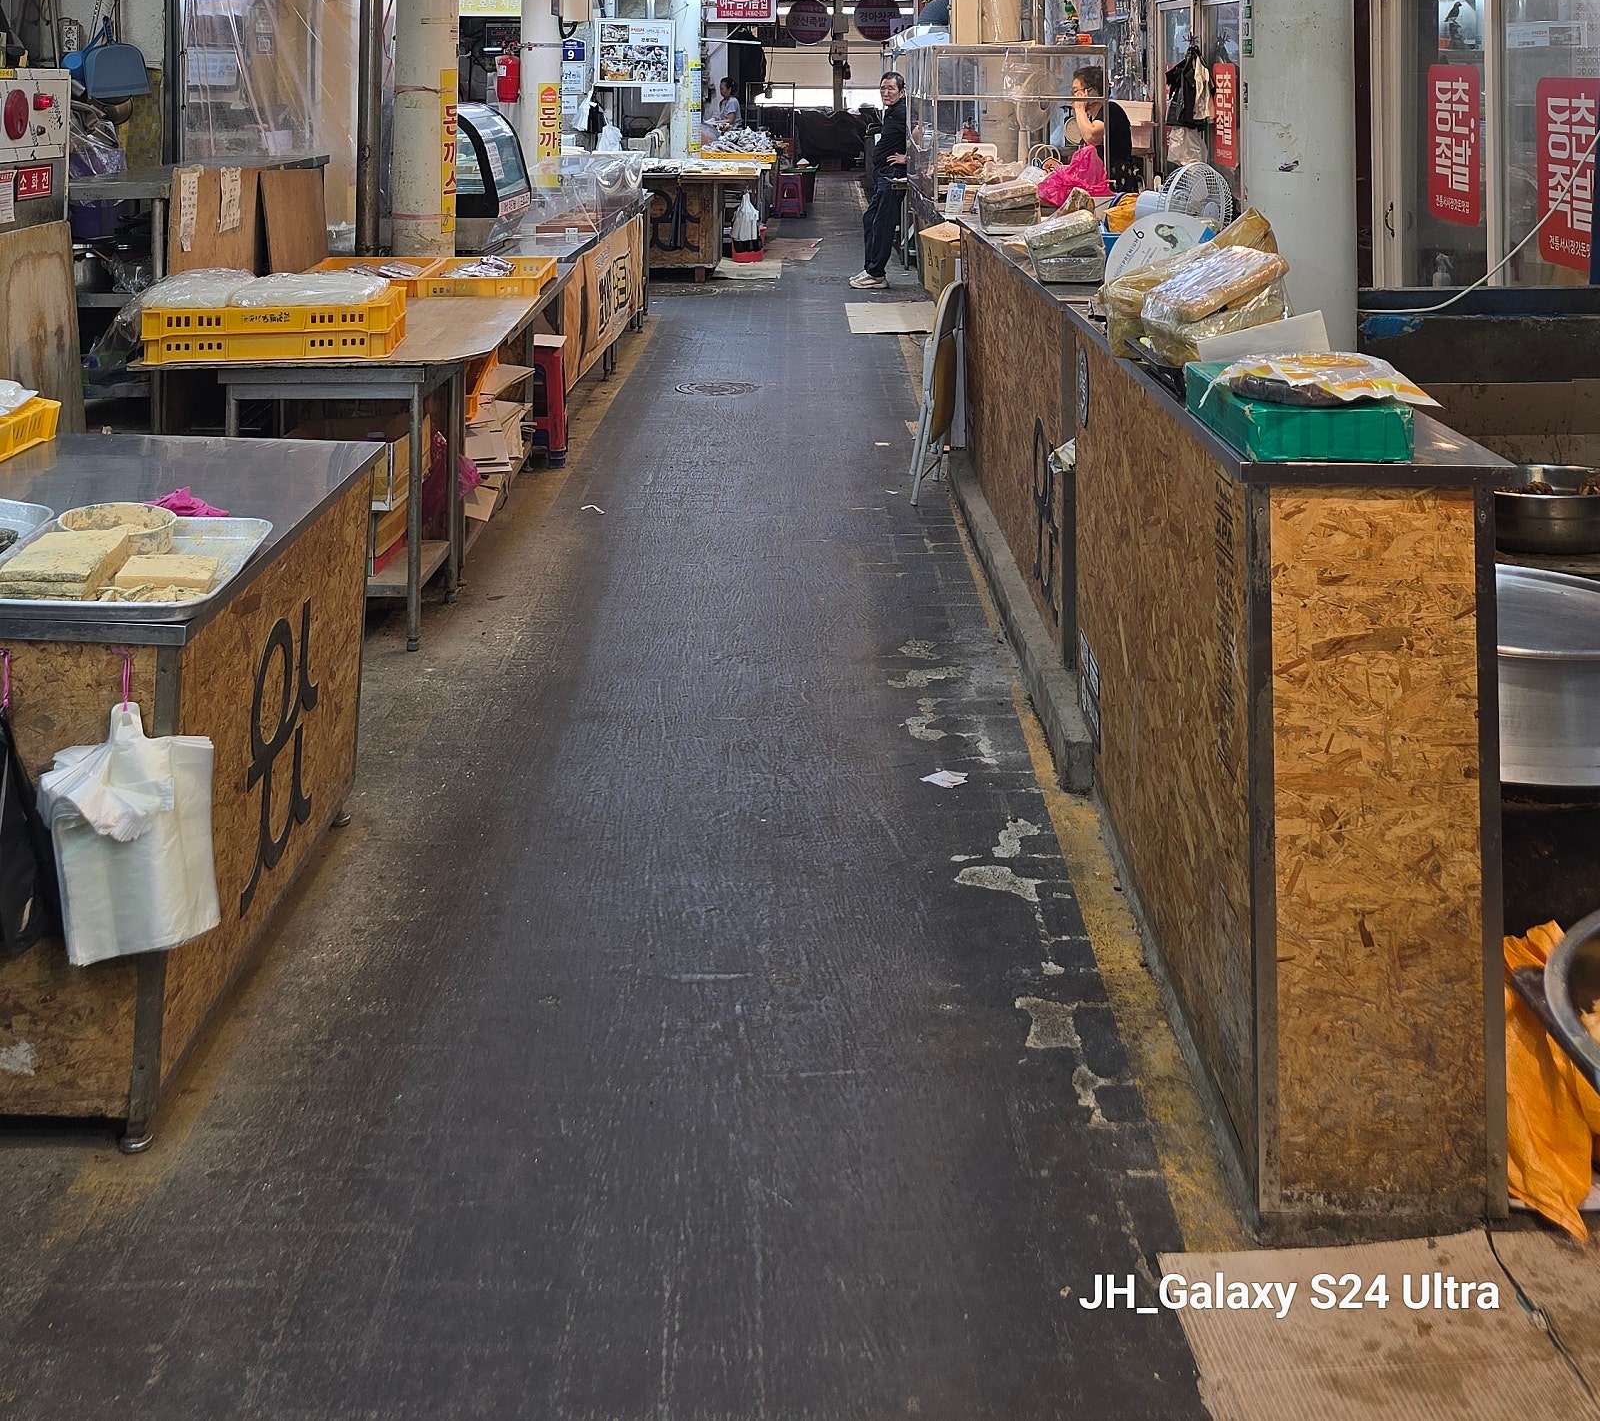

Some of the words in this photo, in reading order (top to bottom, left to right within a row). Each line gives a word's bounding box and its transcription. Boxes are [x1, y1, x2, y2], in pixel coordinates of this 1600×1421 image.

[567, 50, 575, 60] 9
[19, 170, 50, 191] 소화전
[1132, 228, 1145, 240] 6
